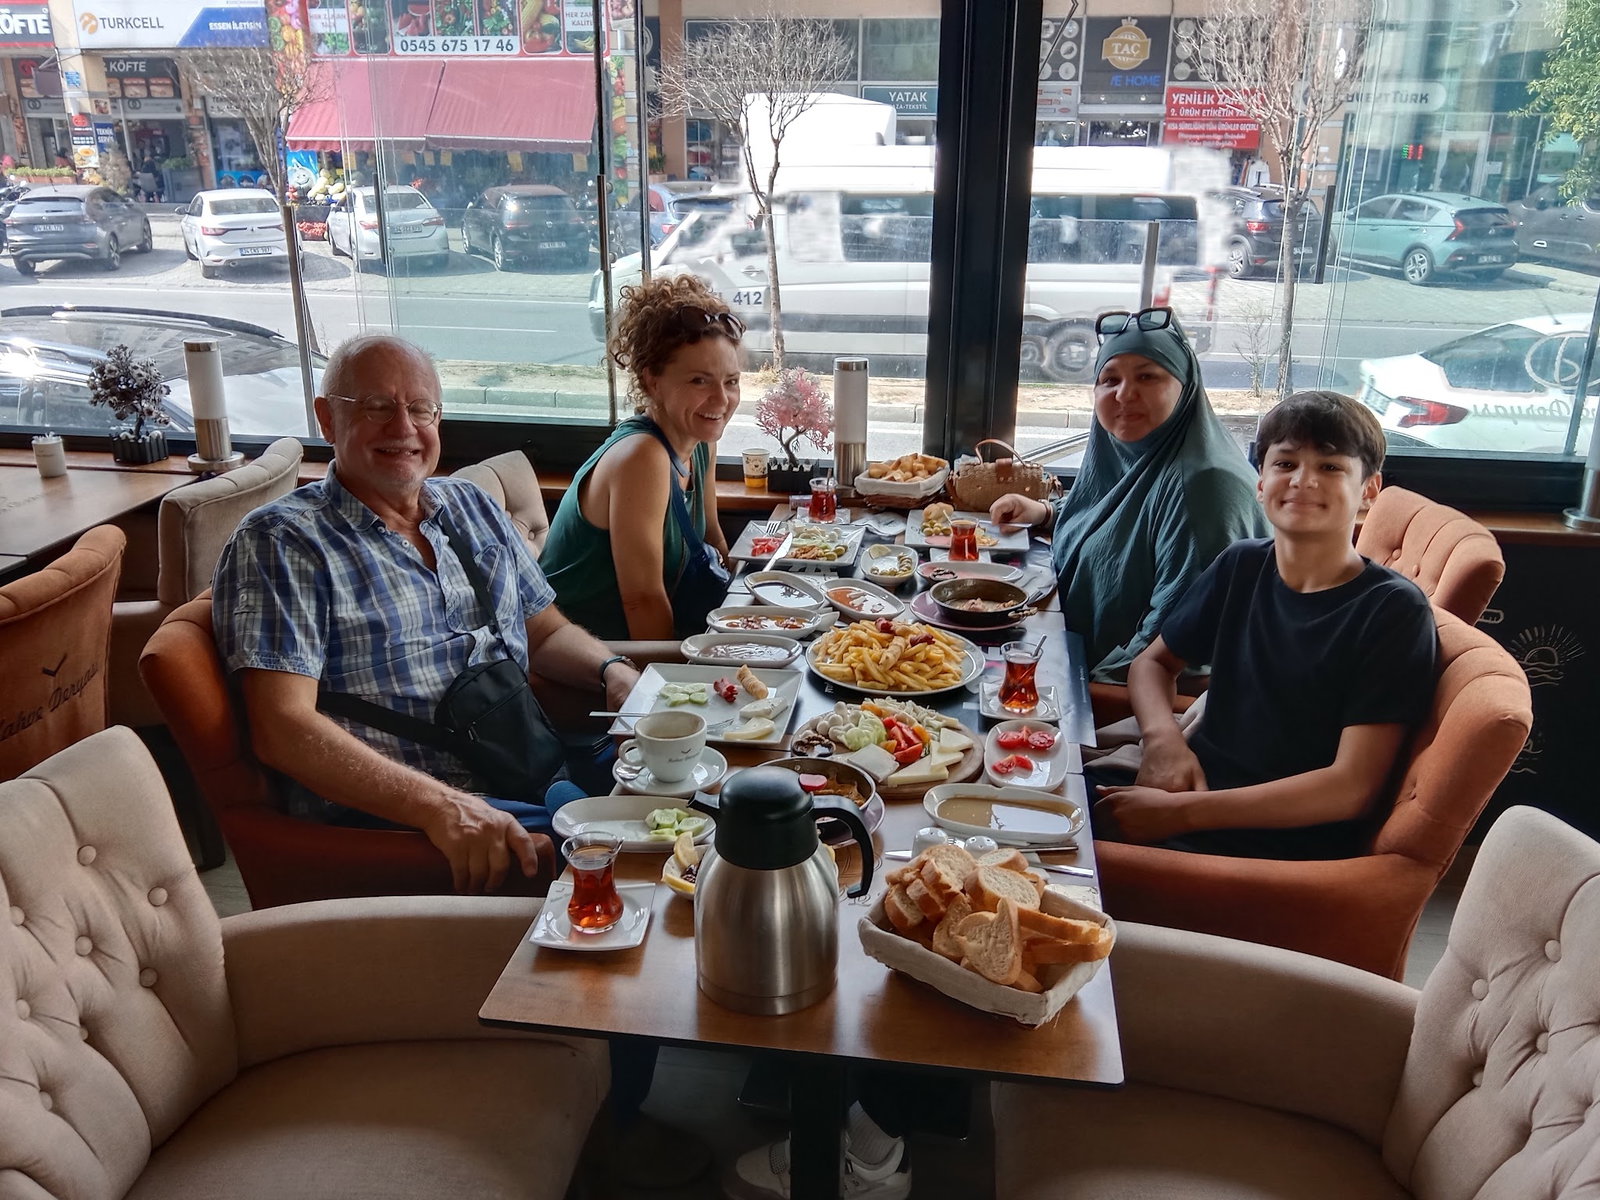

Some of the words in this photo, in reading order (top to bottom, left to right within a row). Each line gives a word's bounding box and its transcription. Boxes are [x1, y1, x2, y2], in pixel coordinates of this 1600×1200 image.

[99, 17, 164, 29] TURKCELL
[400, 39, 436, 52] 0545
[441, 39, 468, 52] 675
[474, 39, 490, 52] 17
[496, 39, 514, 52] 46
[1111, 42, 1141, 57] TAÇ
[109, 60, 146, 72] KÖFTE
[1125, 75, 1161, 86] HOME
[889, 91, 928, 102] YATAK
[1172, 91, 1214, 104] YENİLİK
[1179, 107, 1200, 117] ÜRÜN
[733, 291, 762, 305] 412
